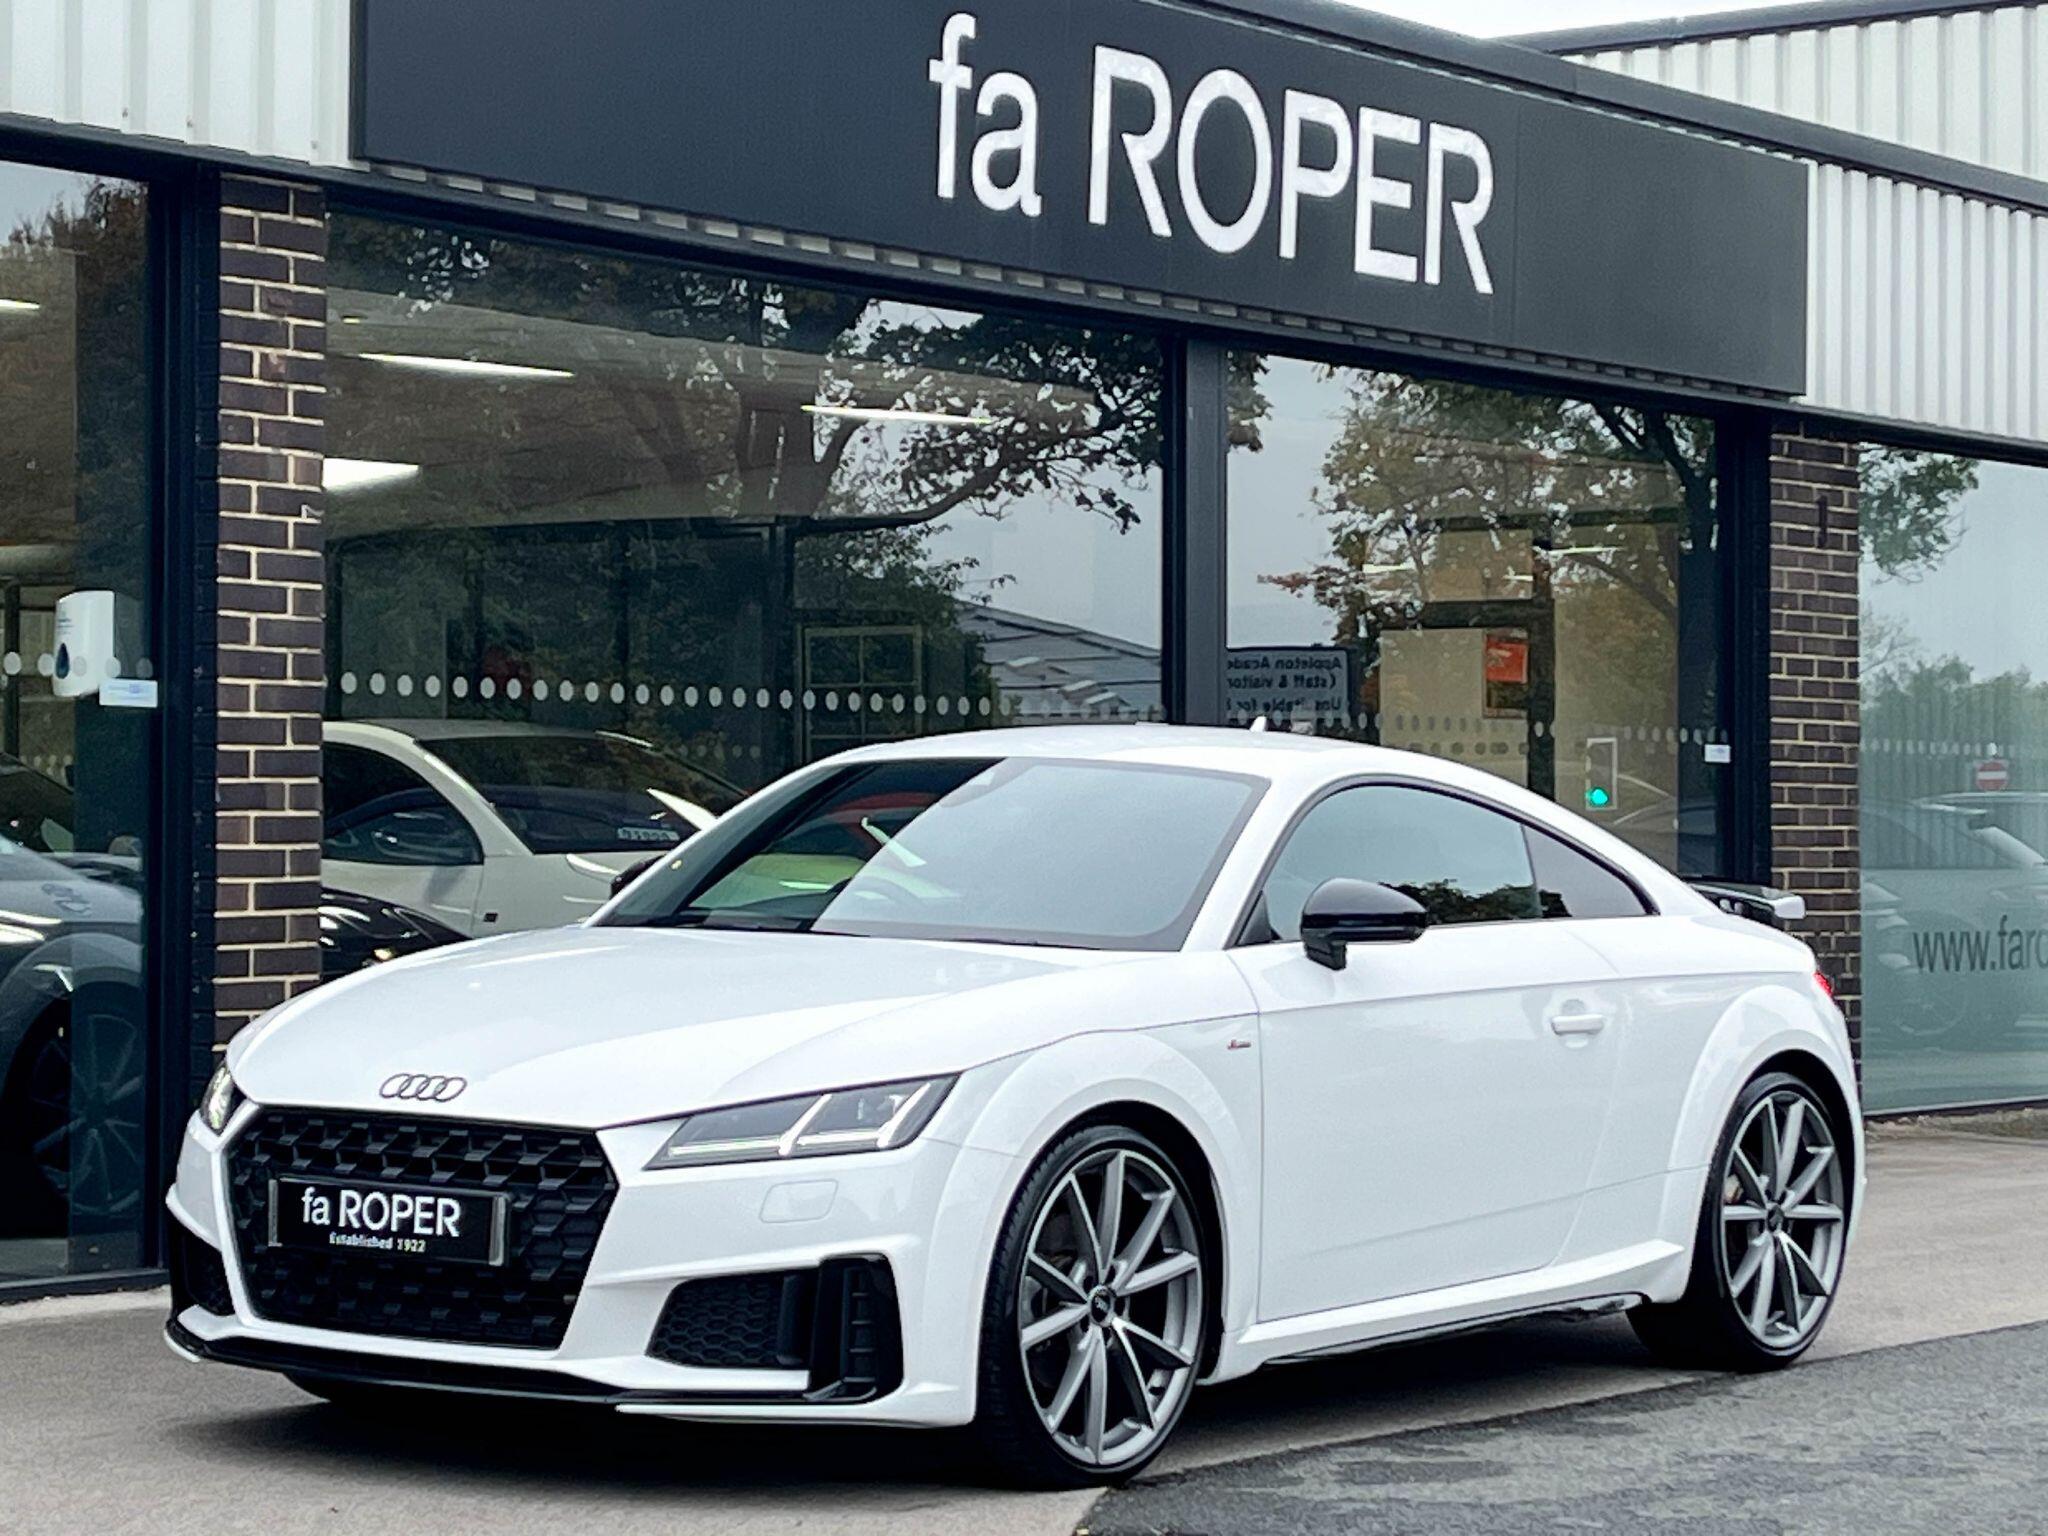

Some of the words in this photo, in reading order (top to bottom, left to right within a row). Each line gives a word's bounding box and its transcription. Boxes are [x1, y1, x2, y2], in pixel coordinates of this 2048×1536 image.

[929, 13, 1042, 217] fa
[1088, 45, 1494, 294] ROPER
[301, 1186, 331, 1225] fa
[338, 1189, 461, 1237] ROPER
[329, 1231, 394, 1250] Established
[397, 1238, 427, 1253] 1922
